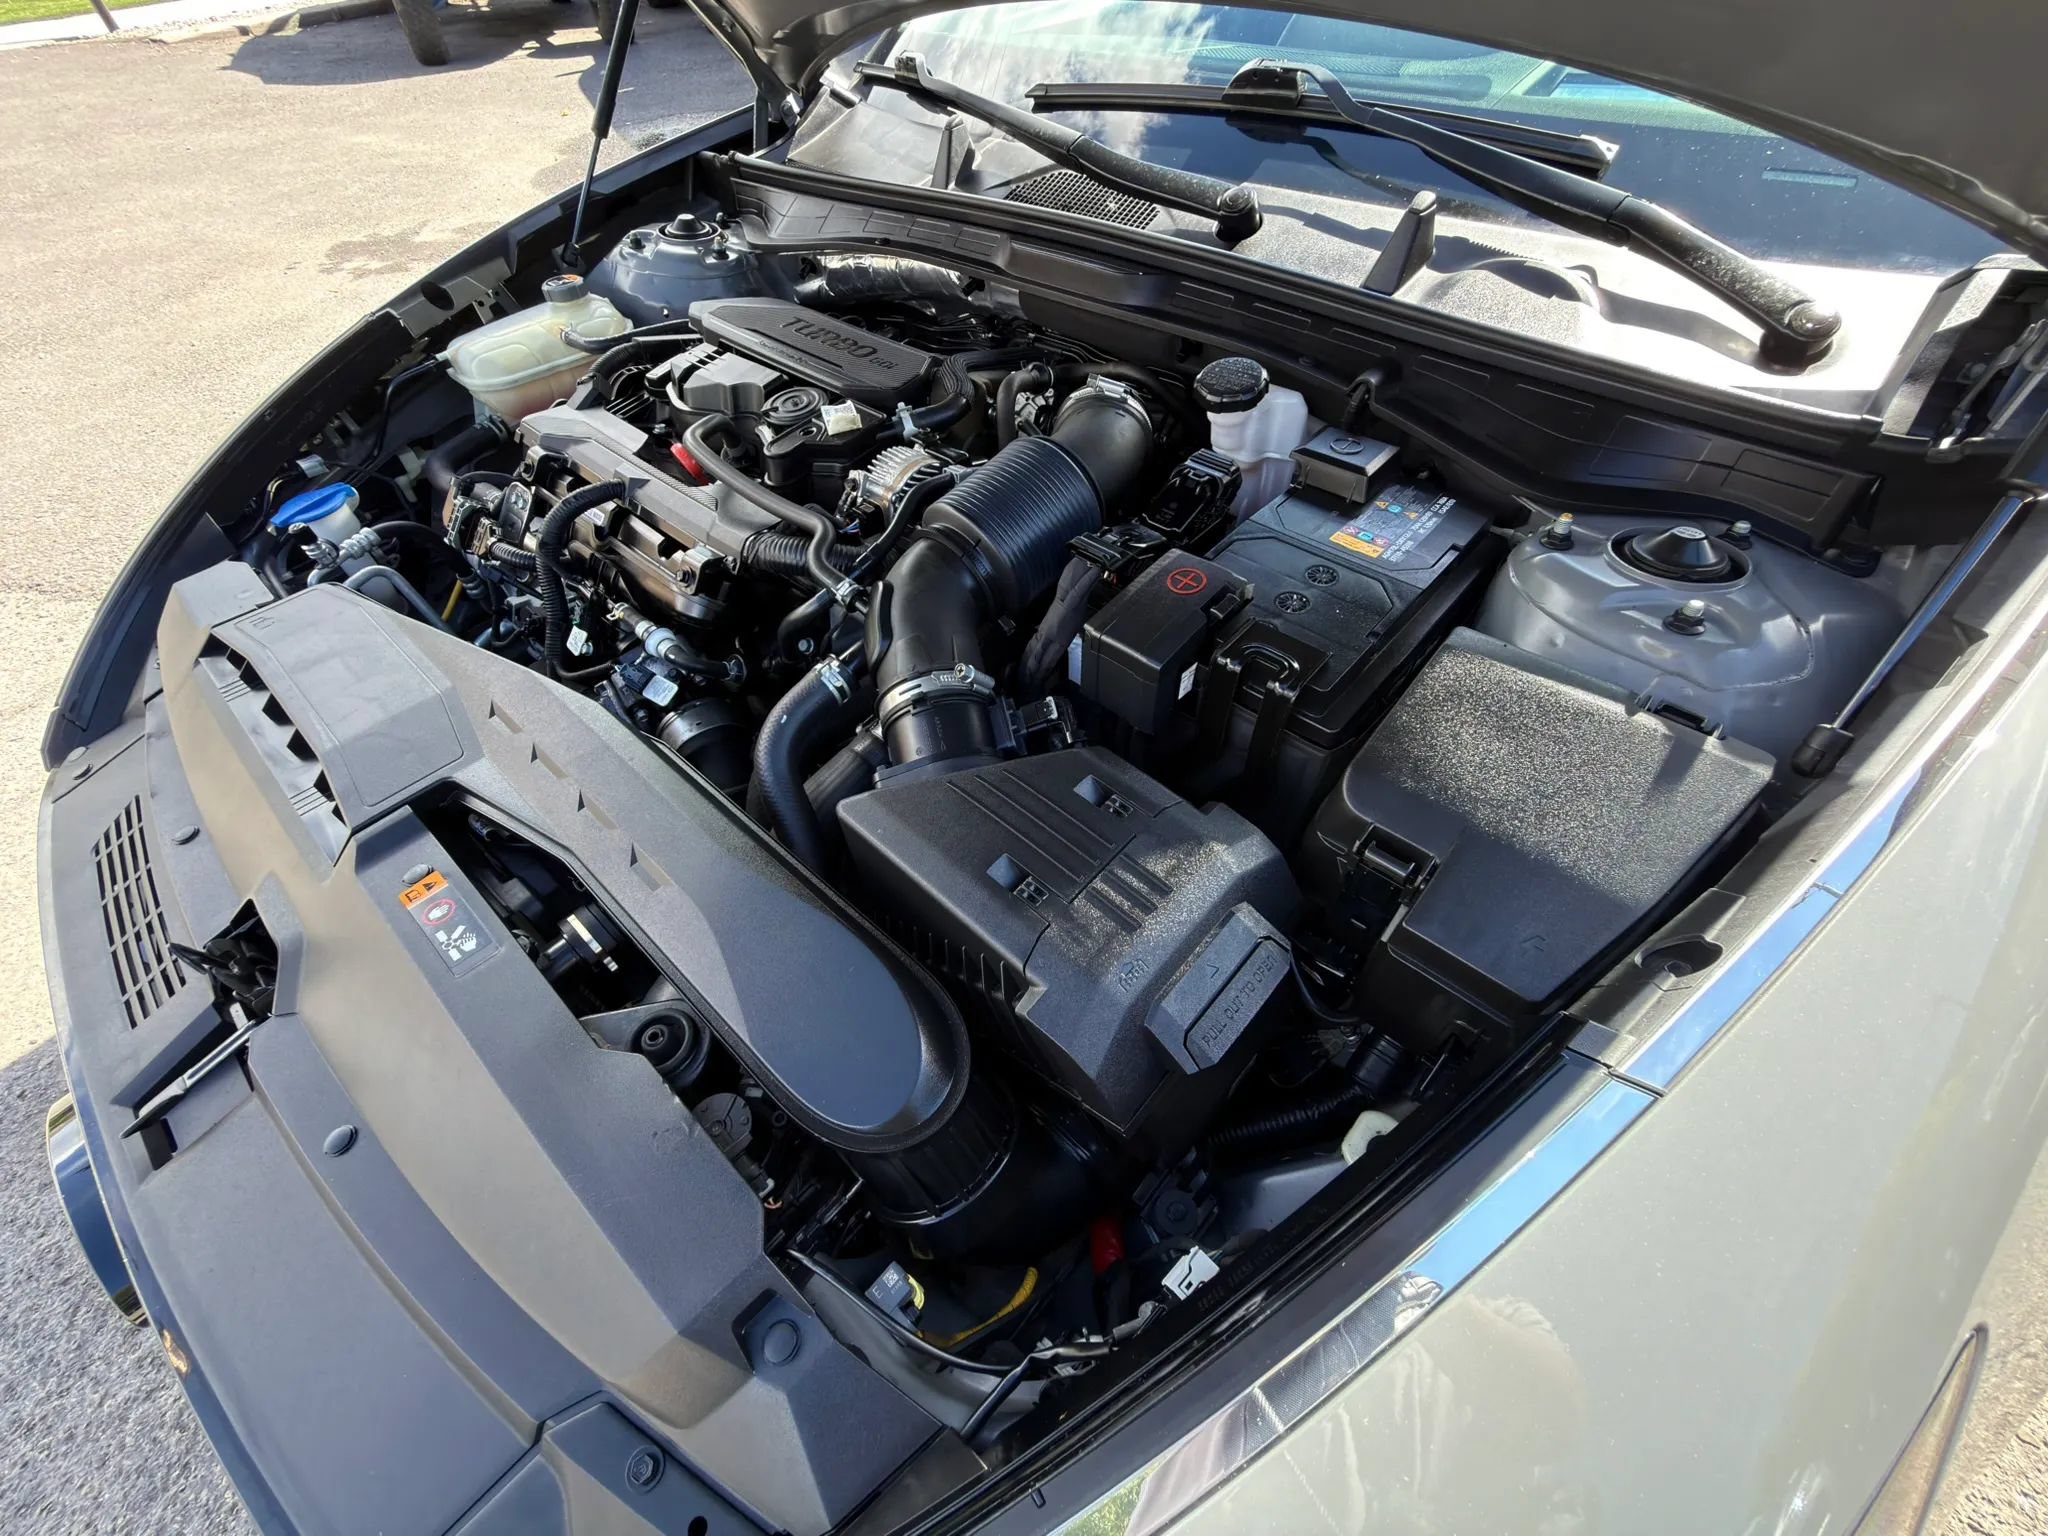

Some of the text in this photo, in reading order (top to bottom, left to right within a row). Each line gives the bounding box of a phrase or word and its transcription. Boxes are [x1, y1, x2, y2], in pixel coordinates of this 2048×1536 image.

[780, 316, 878, 358] TURBO
[1202, 956, 1277, 1048] PULL OUT TO OPEN
